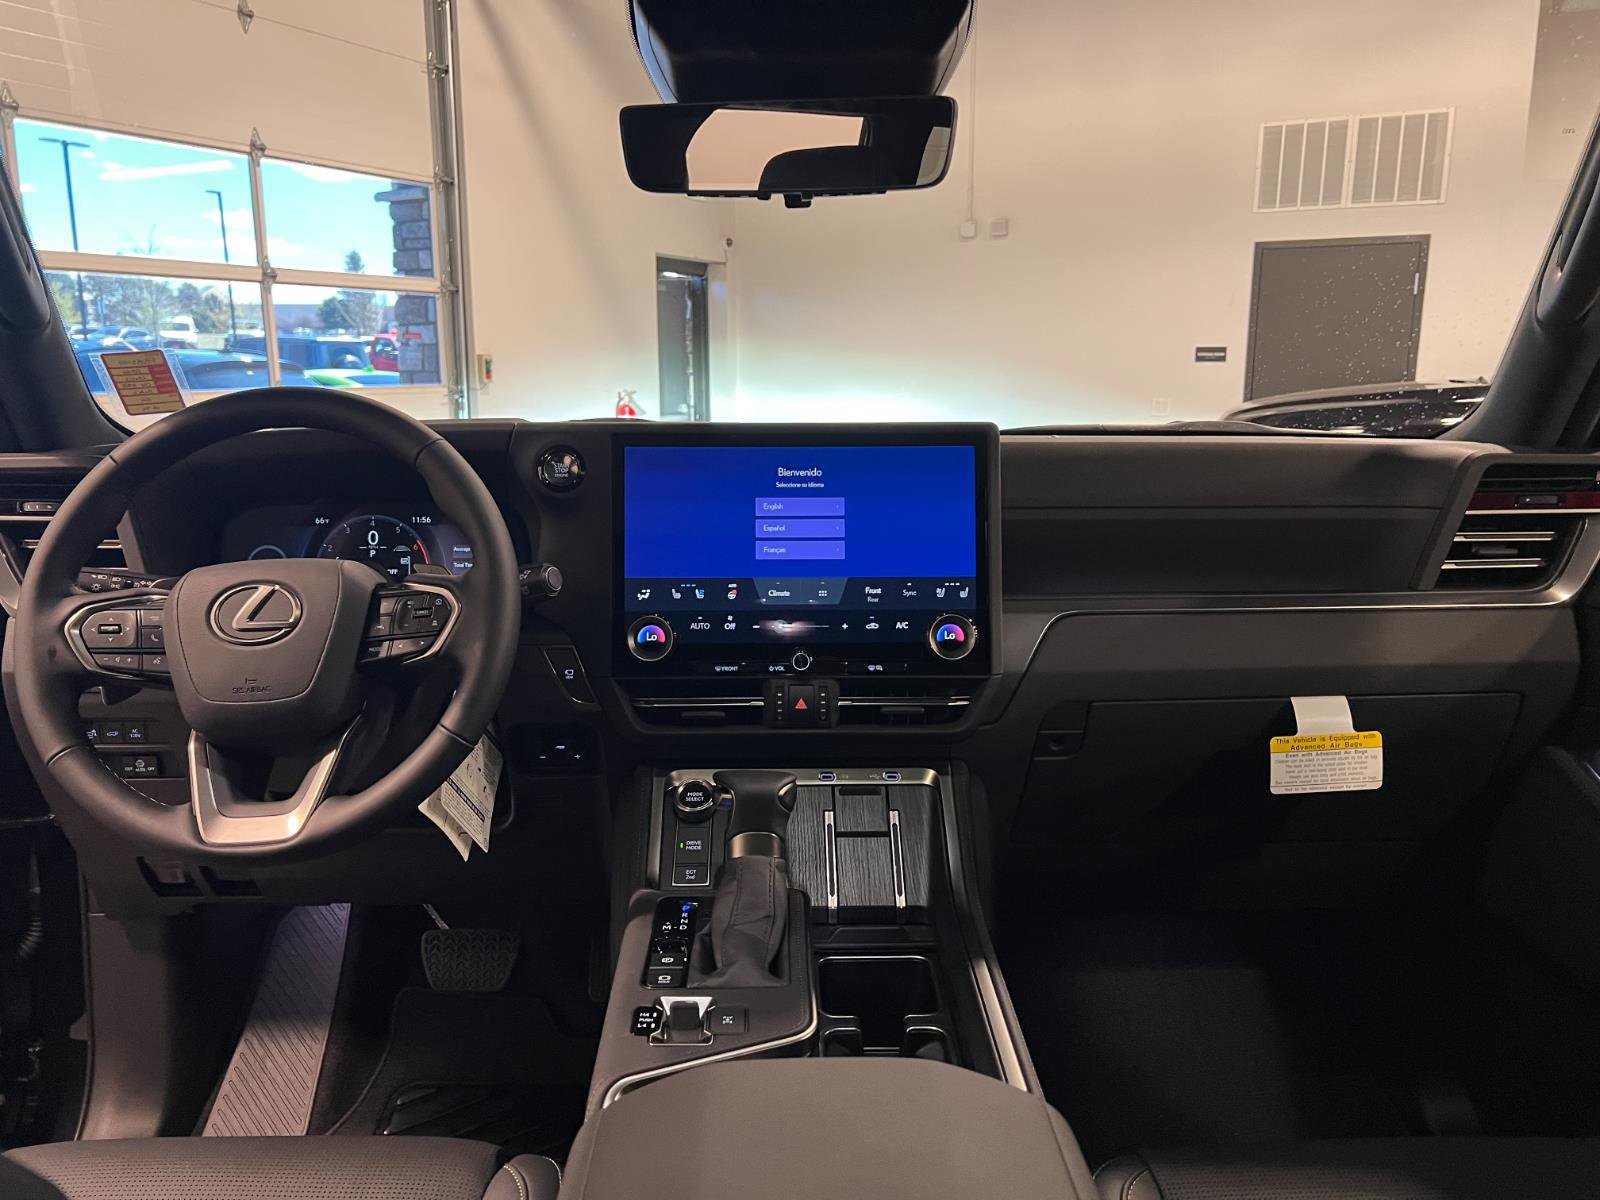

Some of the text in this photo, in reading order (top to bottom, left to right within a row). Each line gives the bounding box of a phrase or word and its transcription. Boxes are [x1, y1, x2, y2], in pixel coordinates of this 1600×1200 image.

[778, 467, 822, 477] Bienvenido
[763, 503, 783, 511] English
[412, 516, 431, 524] 11:56
[763, 524, 785, 532] Español
[763, 546, 786, 554] Français
[903, 589, 917, 597] Sync
[690, 622, 710, 630] AUTO
[724, 622, 736, 630] Off
[646, 632, 657, 641] Lo
[944, 630, 956, 640] Lo
[1329, 734, 1360, 742] Equipped
[1290, 743, 1326, 751] Advanced
[1345, 741, 1363, 749] Bags
